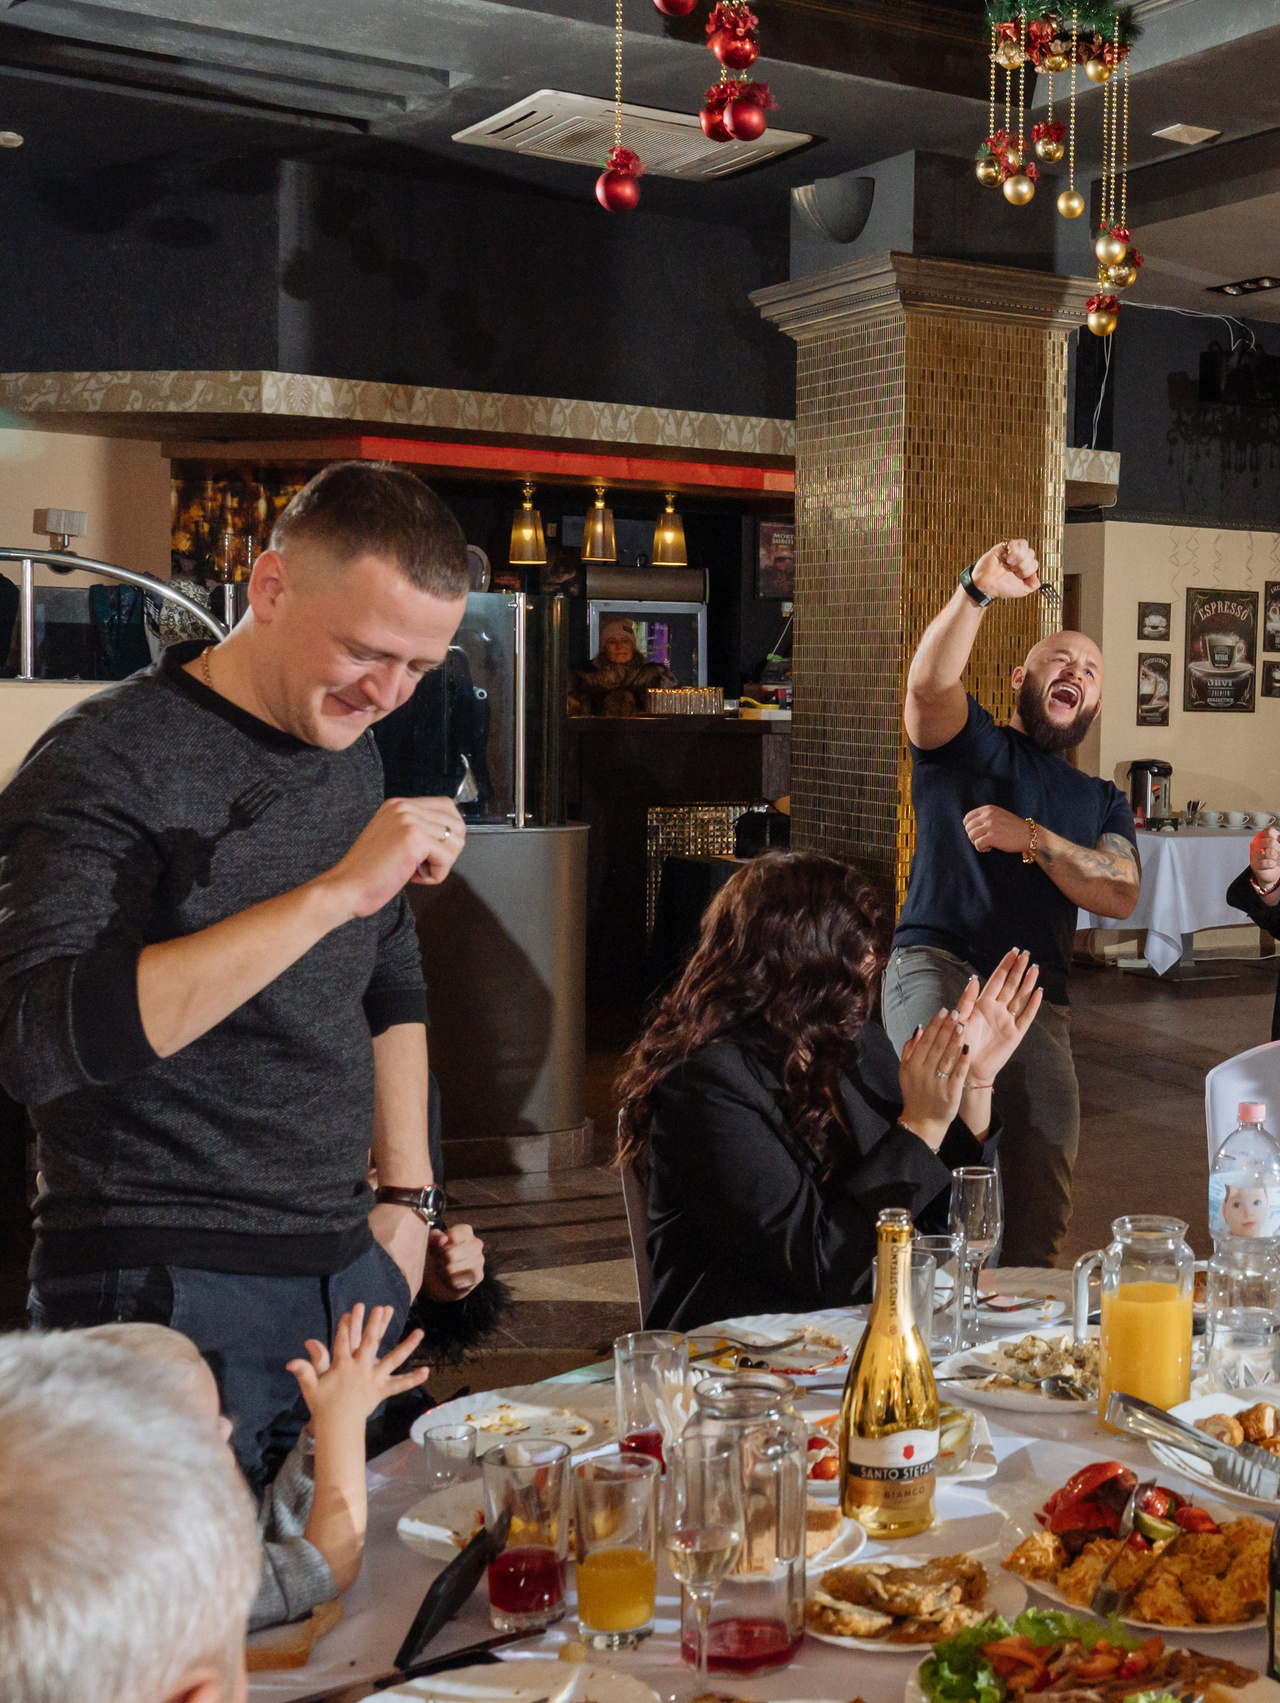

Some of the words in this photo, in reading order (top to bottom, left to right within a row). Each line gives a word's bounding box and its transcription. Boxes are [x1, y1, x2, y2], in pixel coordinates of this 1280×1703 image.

[1197, 600, 1249, 621] ESPRESSO
[890, 1245, 899, 1286] STEFANO
[889, 1287, 898, 1317] SANTO
[861, 1466, 899, 1480] SANTO
[903, 1458, 937, 1479] STEFAN
[884, 1486, 926, 1499] BIANCO
